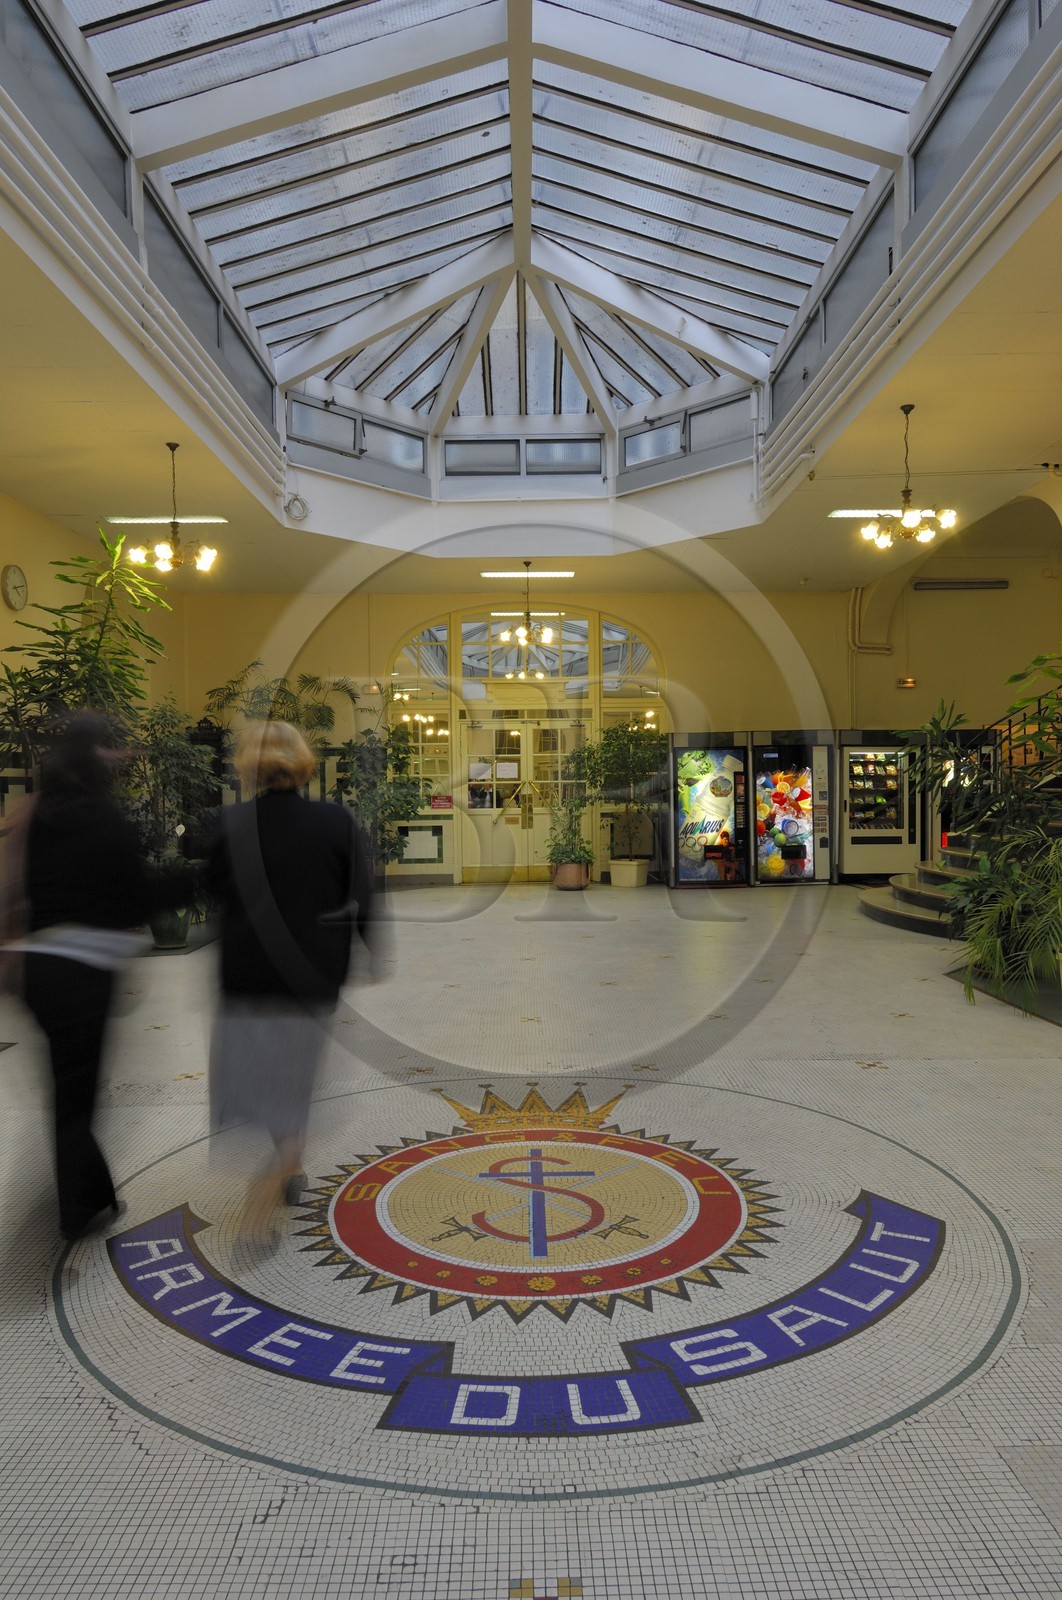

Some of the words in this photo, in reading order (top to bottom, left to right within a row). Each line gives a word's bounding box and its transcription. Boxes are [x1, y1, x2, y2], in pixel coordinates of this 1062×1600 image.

[680, 815, 725, 838] AQUARIUS
[343, 1131, 525, 1203] SANG
[551, 1131, 578, 1143] &
[597, 1134, 731, 1196] FEU
[120, 1237, 412, 1384] ARMEE
[450, 1379, 641, 1427] DU
[670, 1221, 931, 1376] SALUT
